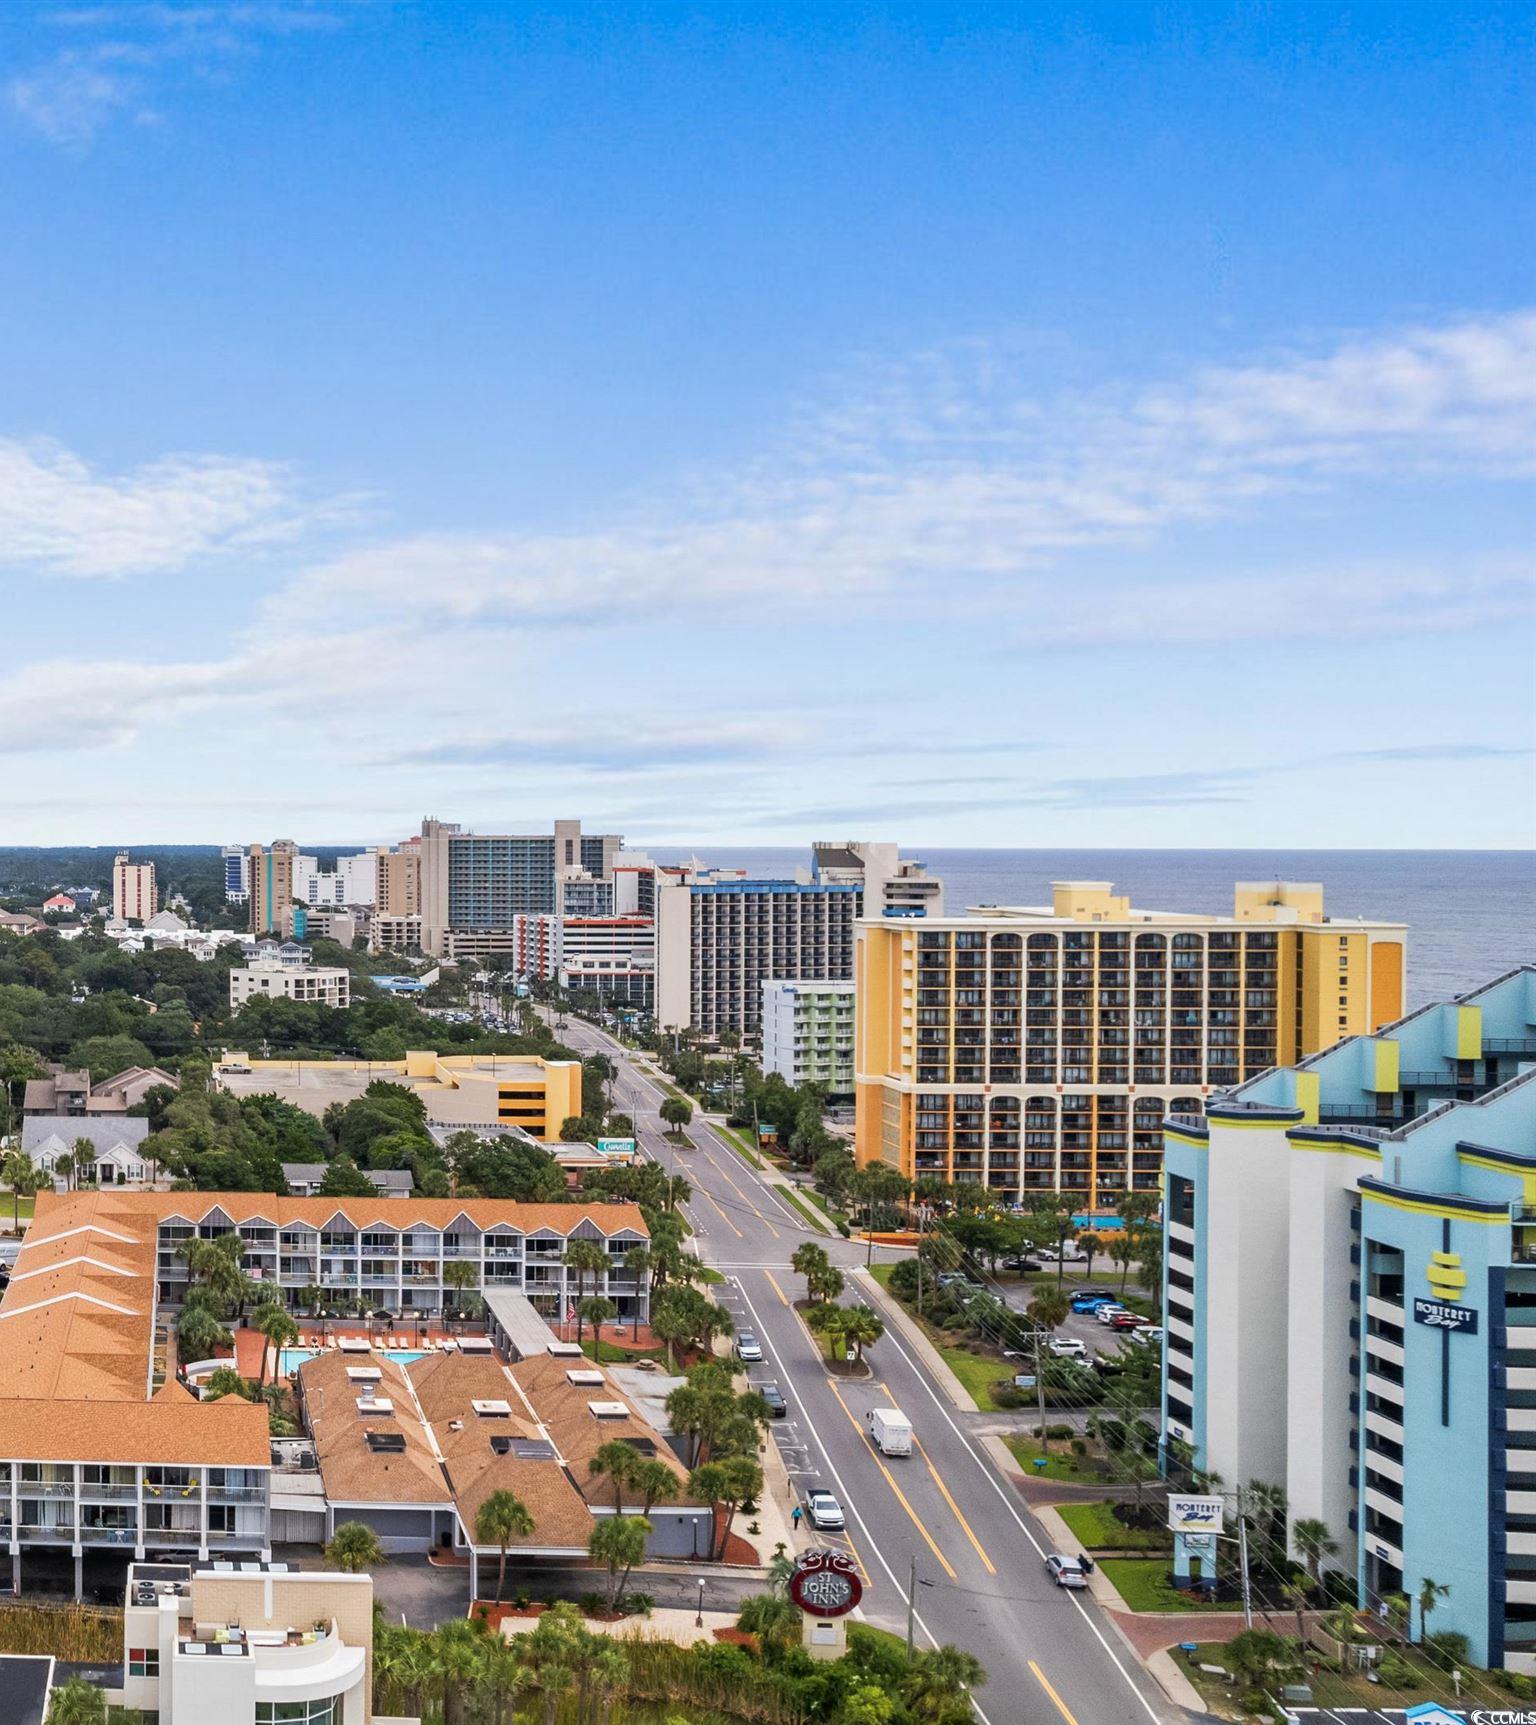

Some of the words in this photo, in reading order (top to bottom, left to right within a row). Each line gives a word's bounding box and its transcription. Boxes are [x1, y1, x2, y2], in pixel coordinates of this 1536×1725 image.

[1416, 1301, 1472, 1321] MONTEREY
[1424, 1314, 1461, 1328] Bay
[1175, 1503, 1221, 1513] MONTEREY
[1183, 1512, 1214, 1522] Bay
[818, 1572, 833, 1582] ST
[803, 1582, 849, 1595] JOHN'S
[813, 1594, 840, 1604] INN
